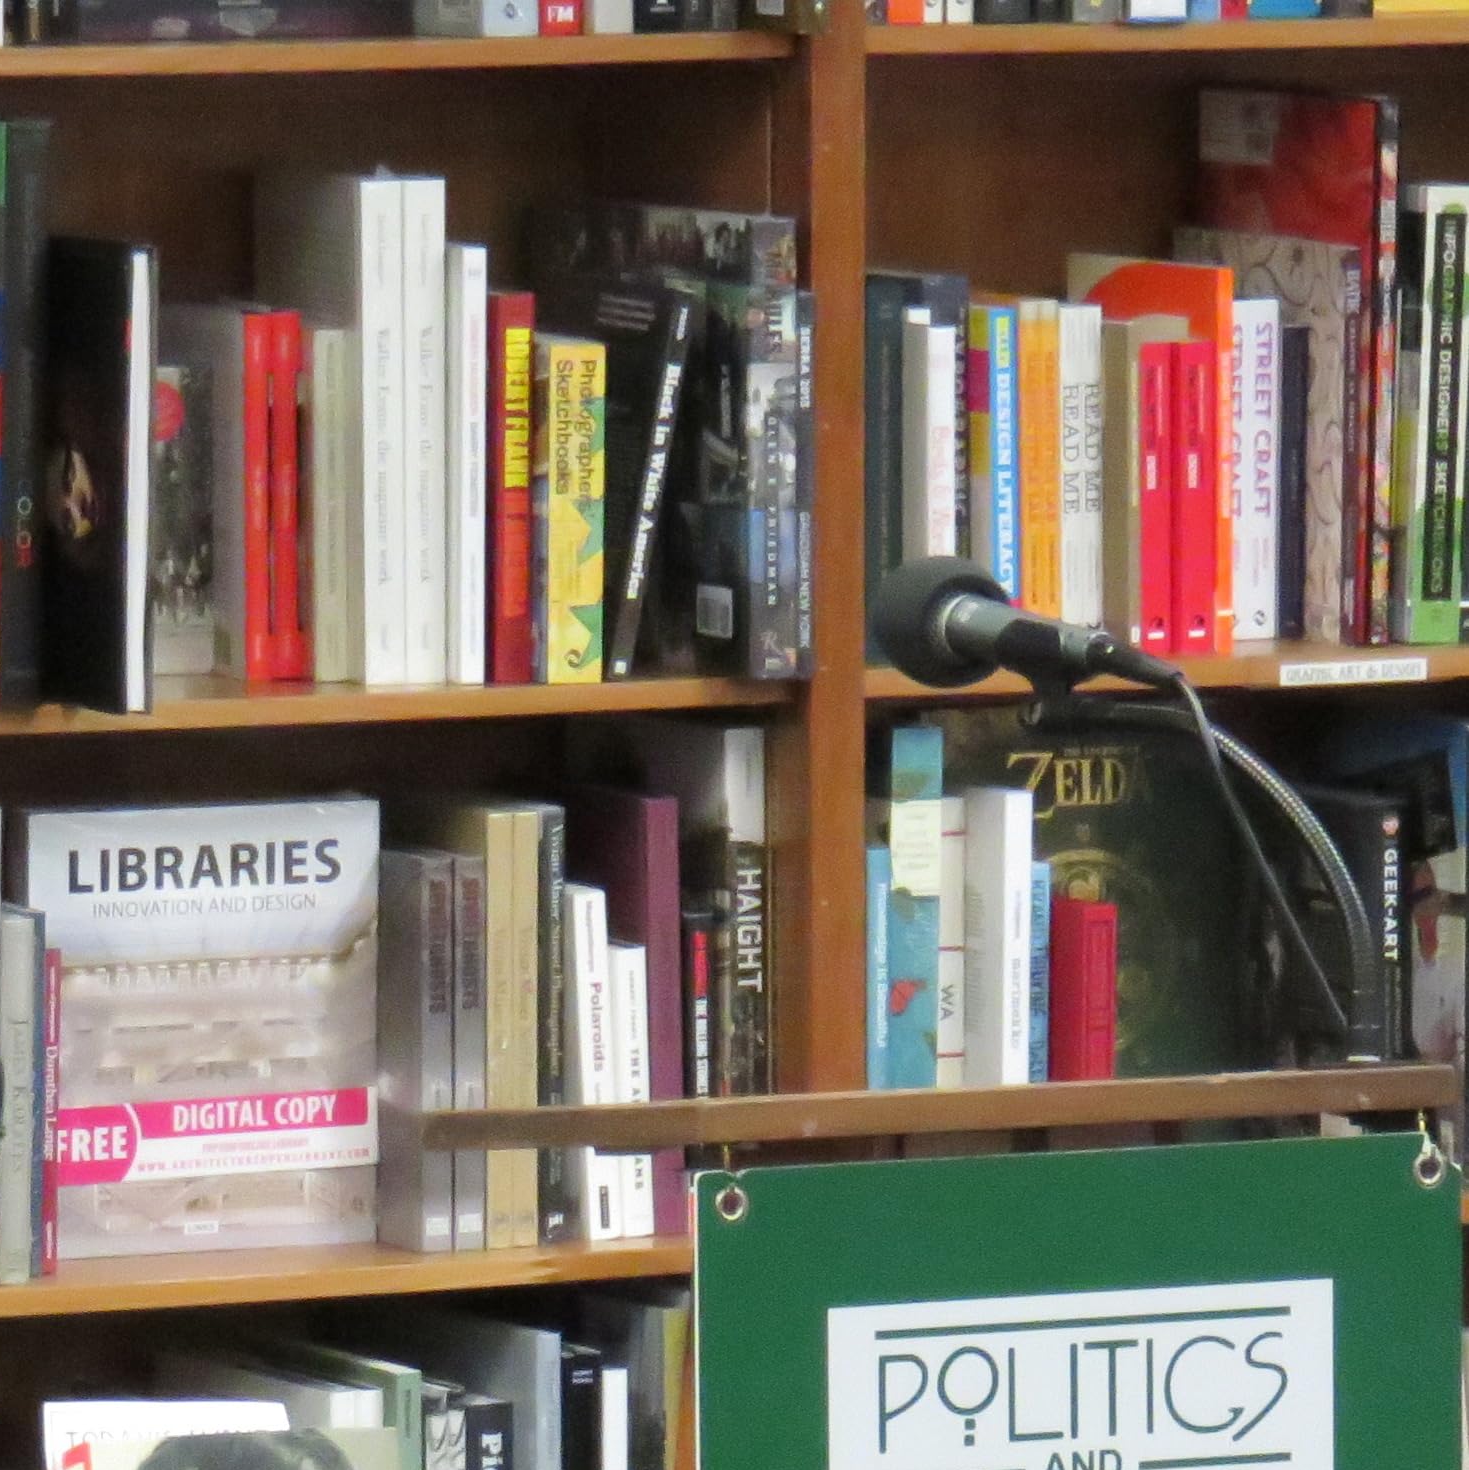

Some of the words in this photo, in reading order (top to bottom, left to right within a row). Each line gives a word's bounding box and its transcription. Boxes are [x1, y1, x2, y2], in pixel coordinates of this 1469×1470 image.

[1439, 221, 1457, 344] INFOGRAPHIC
[505, 327, 530, 413] ROBERT
[799, 326, 810, 374] SERRA
[1253, 322, 1273, 417] STREET
[657, 363, 681, 420] Black
[995, 371, 1012, 467] DESIGN
[1063, 384, 1080, 463] READ
[1084, 383, 1100, 461] READ
[504, 417, 529, 488] FRANK
[555, 358, 573, 496] Sketchbooks
[641, 451, 667, 511] White
[1063, 471, 1080, 515] ME
[1084, 470, 1100, 514] ME
[1253, 429, 1273, 517] CRAFT
[625, 515, 654, 600] America
[767, 506, 777, 607] FRIEDMAN
[995, 472, 1016, 596] LITERACY
[799, 581, 810, 608] NEW
[799, 611, 810, 649] YORK
[1006, 751, 1144, 820] ZELD
[68, 838, 342, 894] LIBRARIES
[551, 824, 565, 872] Vivian
[92, 899, 203, 919] INNOVATION
[208, 896, 247, 915] AND
[252, 893, 317, 912] DESIGN
[551, 878, 564, 920] Maier
[737, 868, 763, 993] HAIGHT
[874, 882, 888, 964] Knowledge
[1383, 848, 1399, 961] GEEK-ART
[590, 981, 606, 1072] Polaroids
[876, 983, 888, 1048] Beautiful
[44, 1044, 58, 1114] Dorothea
[631, 1048, 641, 1079] THE
[43, 1118, 57, 1160] Lange
[57, 1125, 128, 1164] FREE
[173, 1100, 268, 1133] DIGITAL
[273, 1094, 337, 1126] COPY
[878, 1331, 1289, 1454] POLITICS
